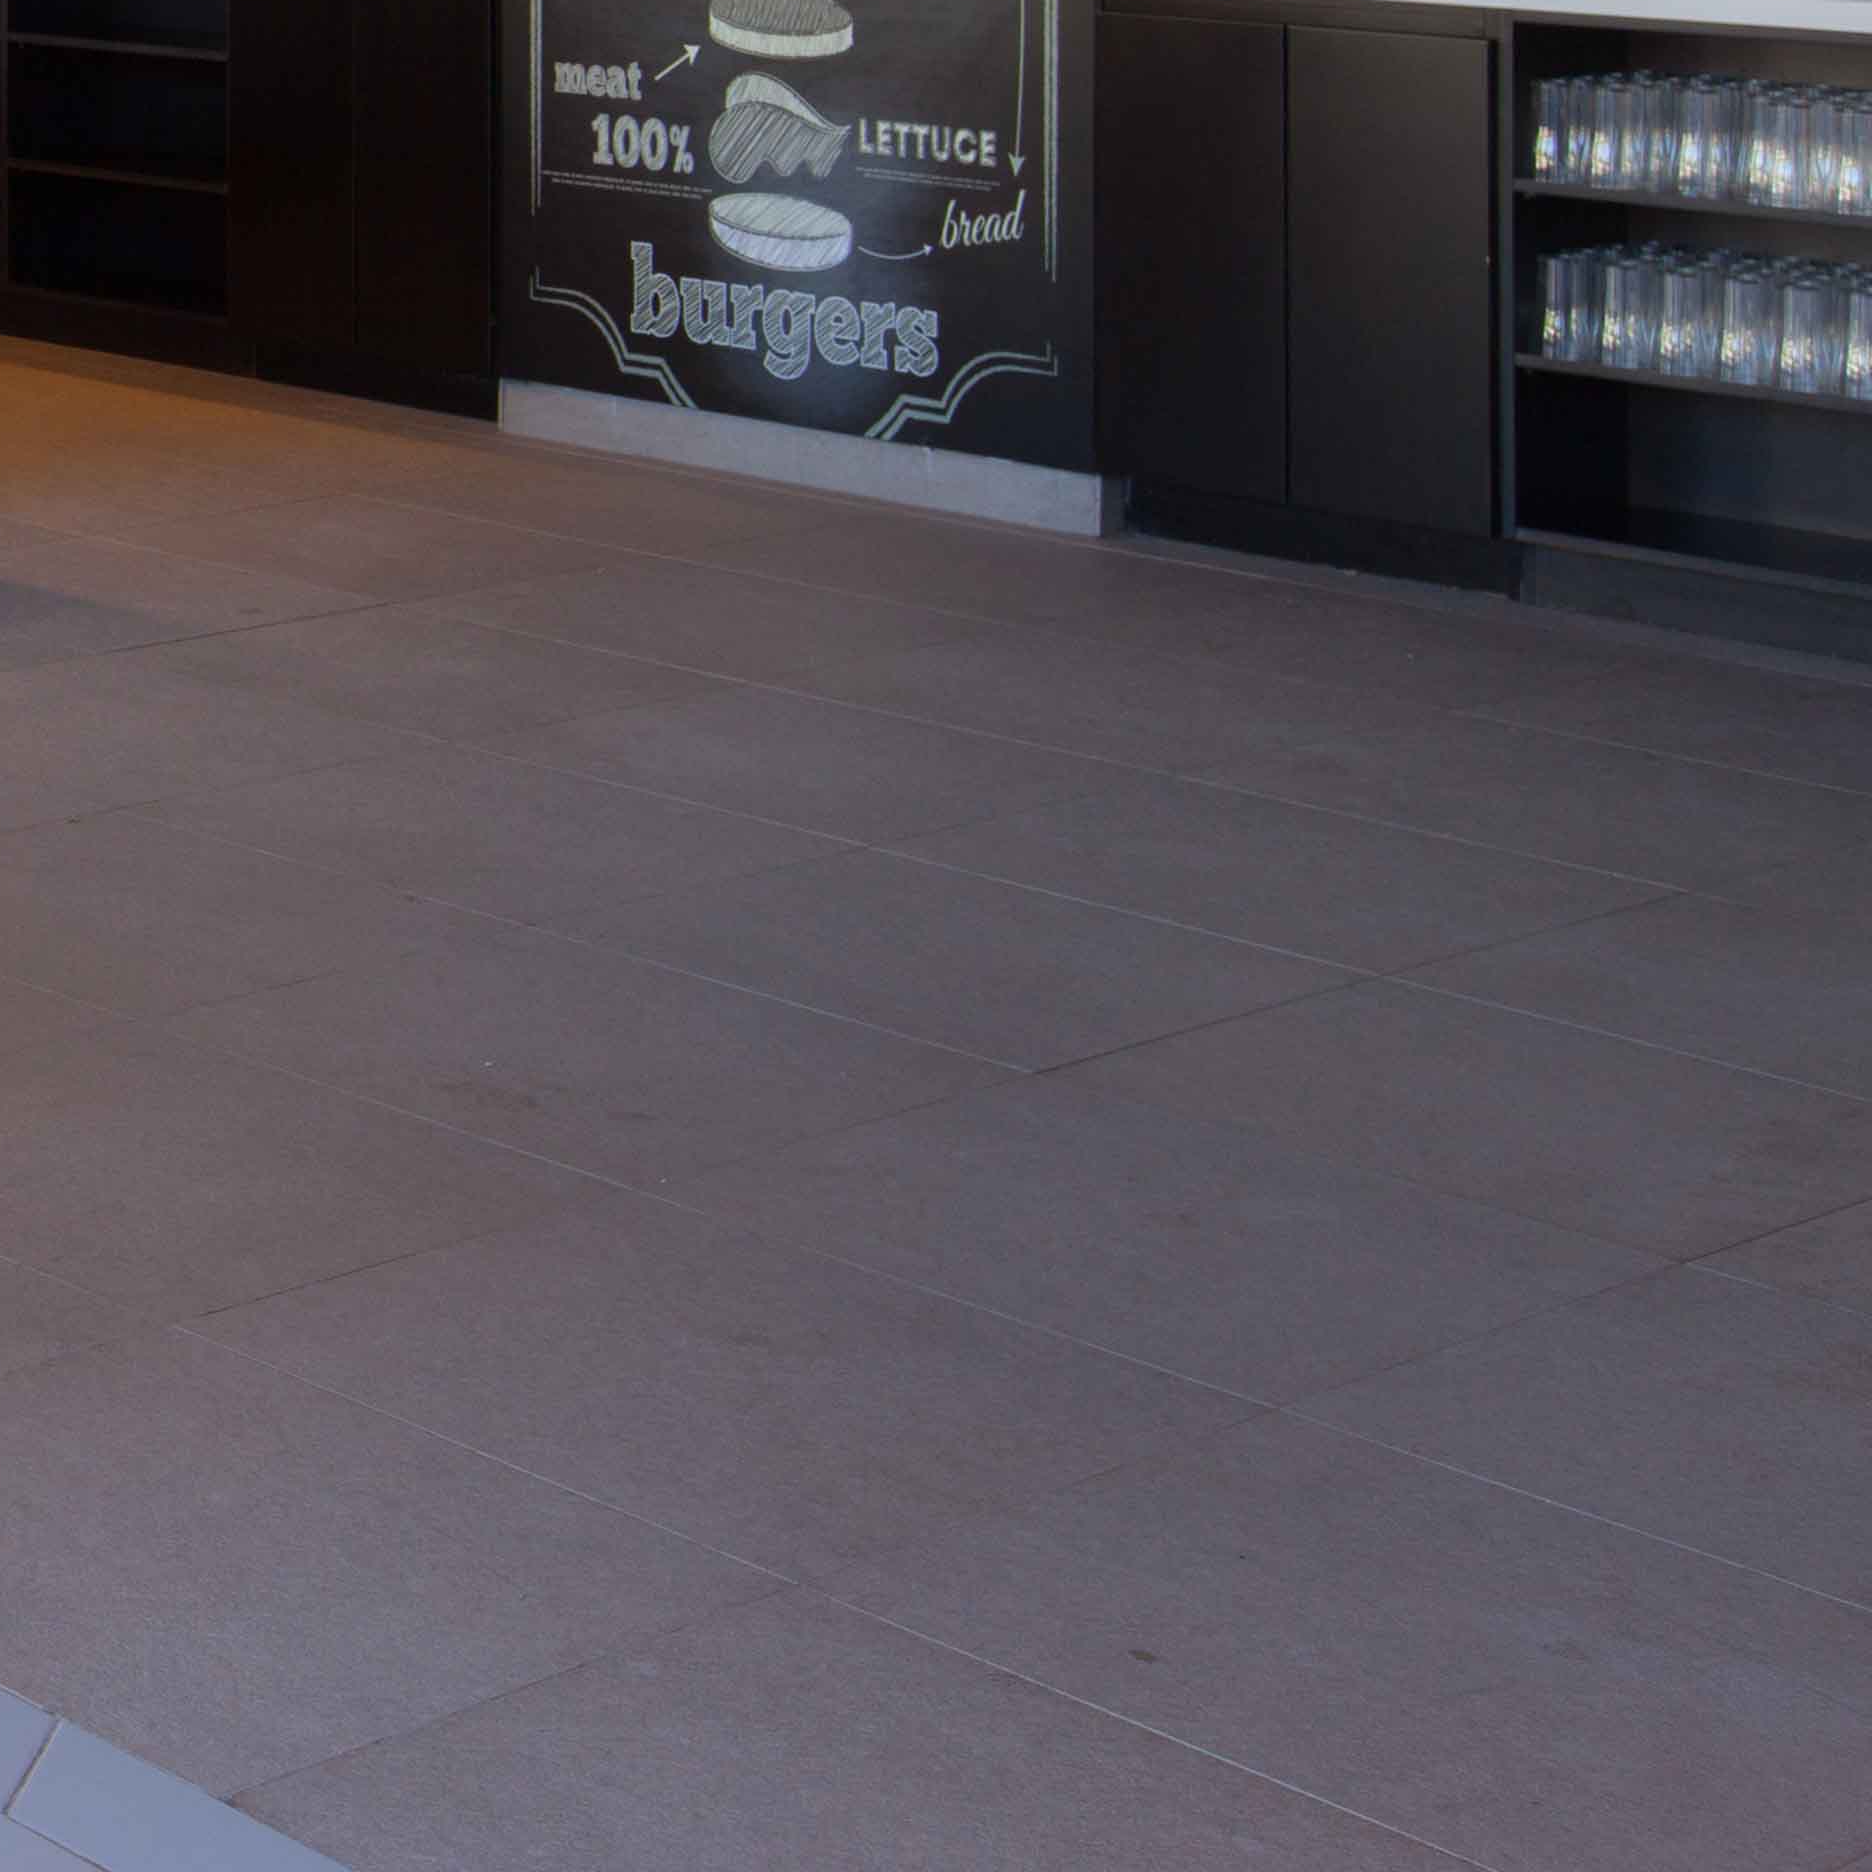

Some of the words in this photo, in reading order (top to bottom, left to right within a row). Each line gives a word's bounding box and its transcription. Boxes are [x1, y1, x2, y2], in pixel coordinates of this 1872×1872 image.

[554, 60, 642, 100] meat
[591, 115, 695, 176] 100%
[856, 119, 999, 167] LETTUCE
[939, 190, 1026, 250] bread
[630, 242, 939, 380] burgers
